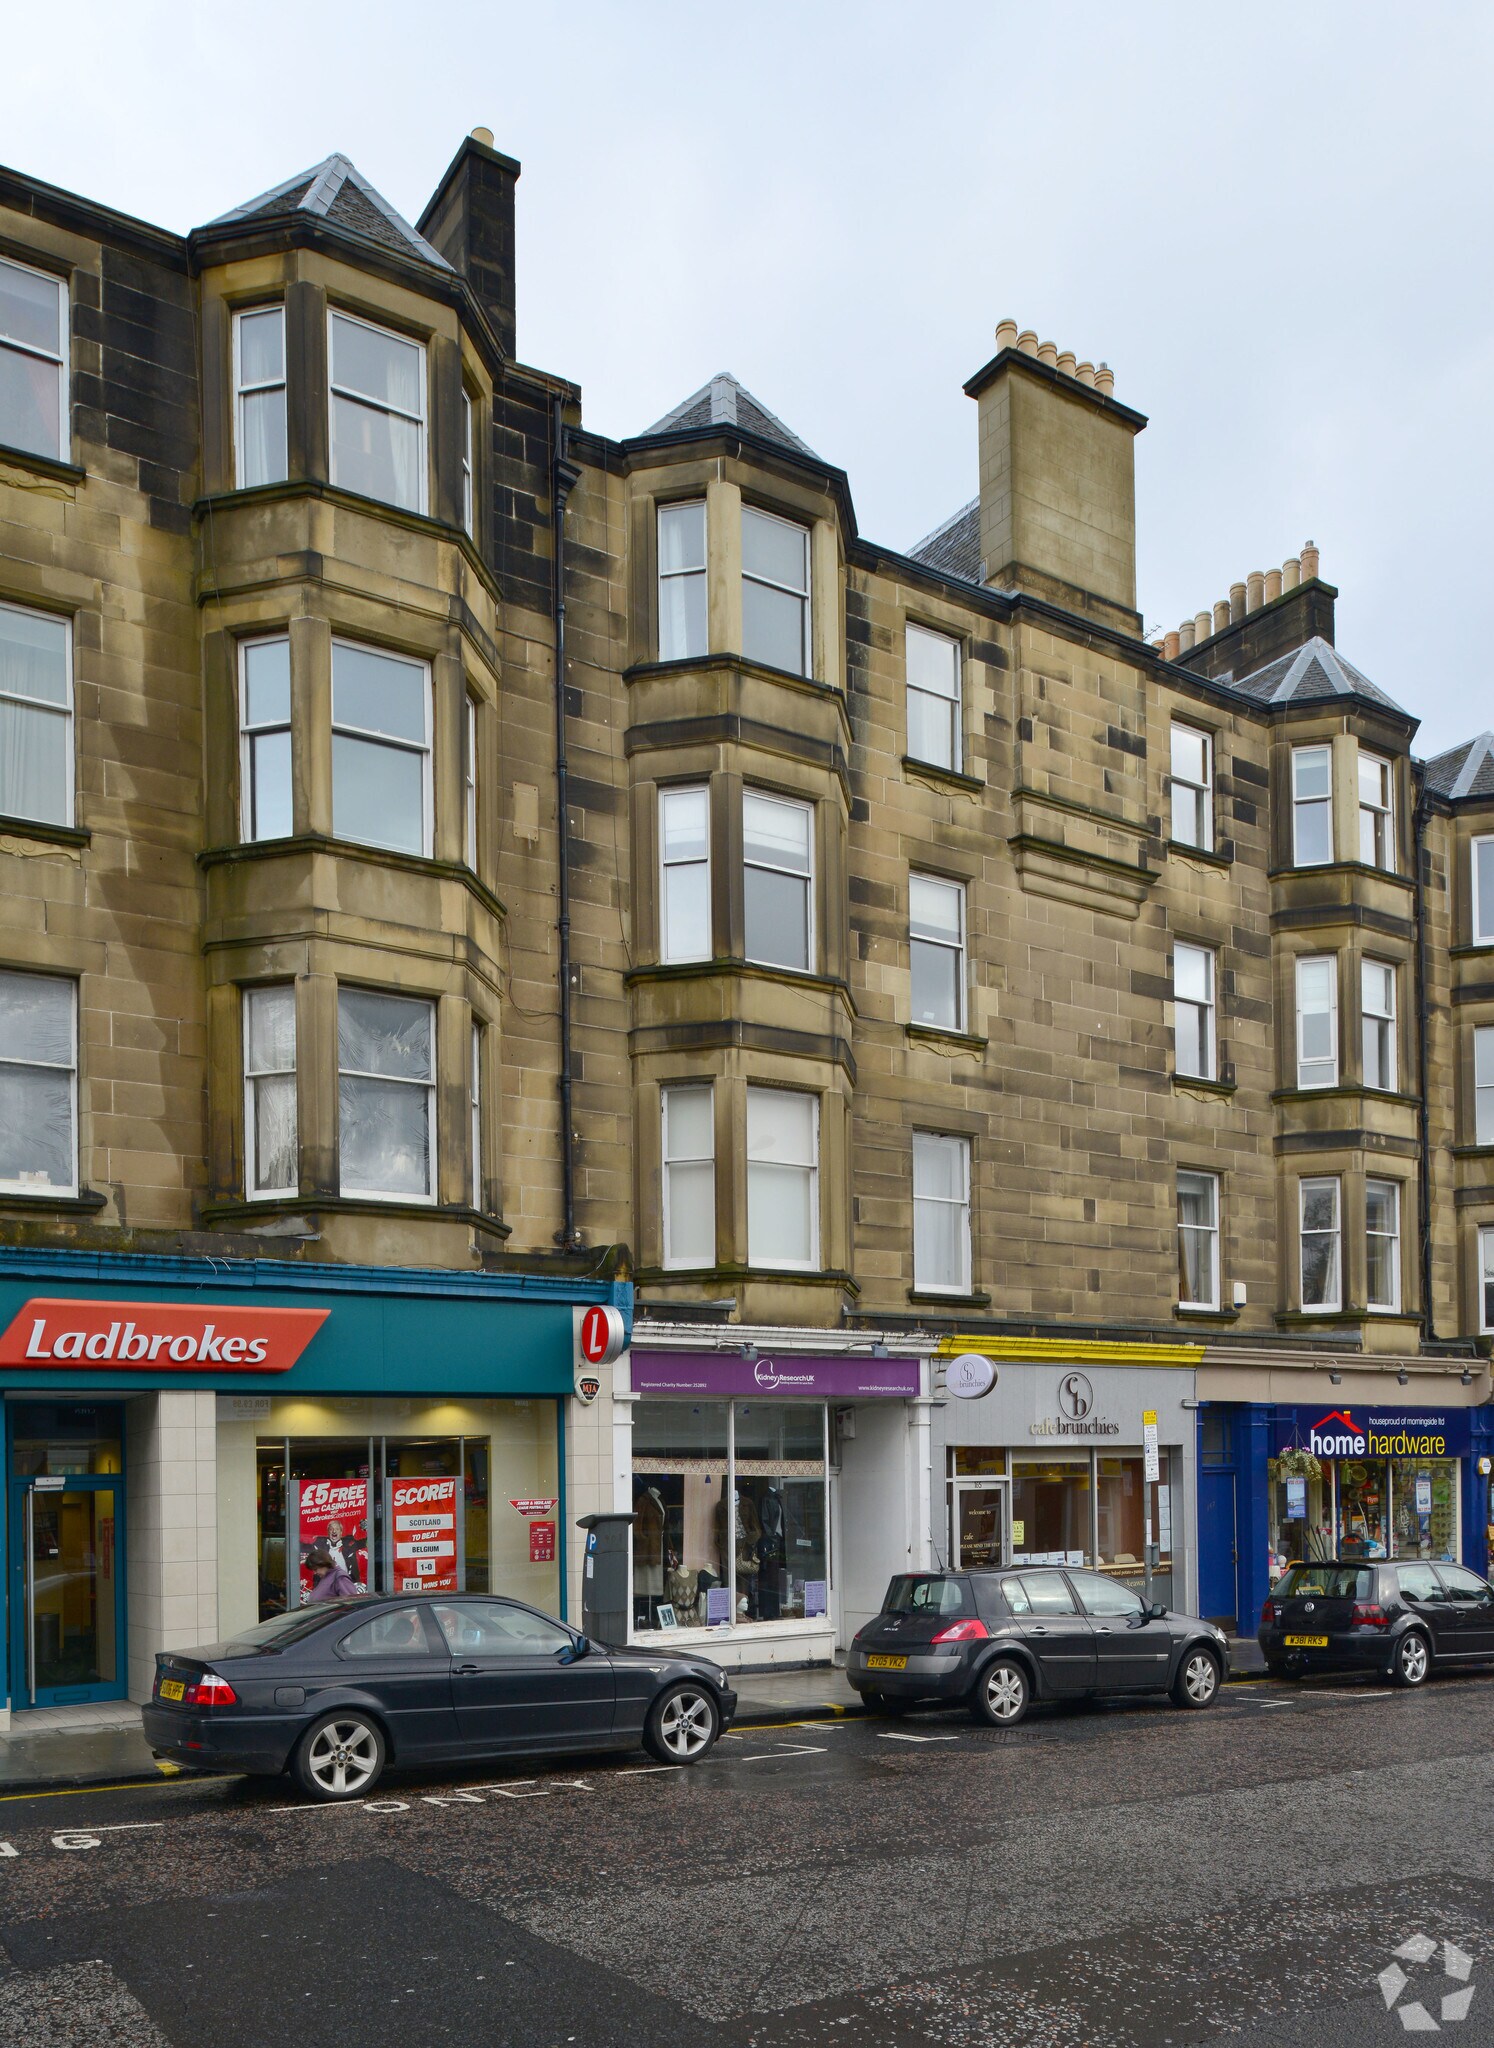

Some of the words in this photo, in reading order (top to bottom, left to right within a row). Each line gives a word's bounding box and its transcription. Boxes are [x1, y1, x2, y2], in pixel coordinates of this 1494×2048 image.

[590, 1314, 602, 1354] L
[25, 1319, 269, 1364] Ladbrokes
[758, 1374, 778, 1382] Kidney
[1369, 1416, 1400, 1426] houseproud
[1401, 1416, 1407, 1425] of
[1407, 1416, 1437, 1427] morningside
[1311, 1430, 1365, 1455] home
[1369, 1430, 1445, 1455] hardware
[301, 1482, 331, 1507] £5
[329, 1484, 367, 1503] FREE
[394, 1481, 454, 1506] SCORE!
[302, 1507, 320, 1515] ONLINE
[321, 1502, 347, 1512] CASINO
[348, 1499, 367, 1508] PLAY
[422, 1531, 439, 1540] BEAT
[405, 1582, 419, 1590] £10
[439, 1578, 451, 1586] YOU
[1307, 1637, 1323, 1645] RKS
[870, 1656, 888, 1666] SY05
